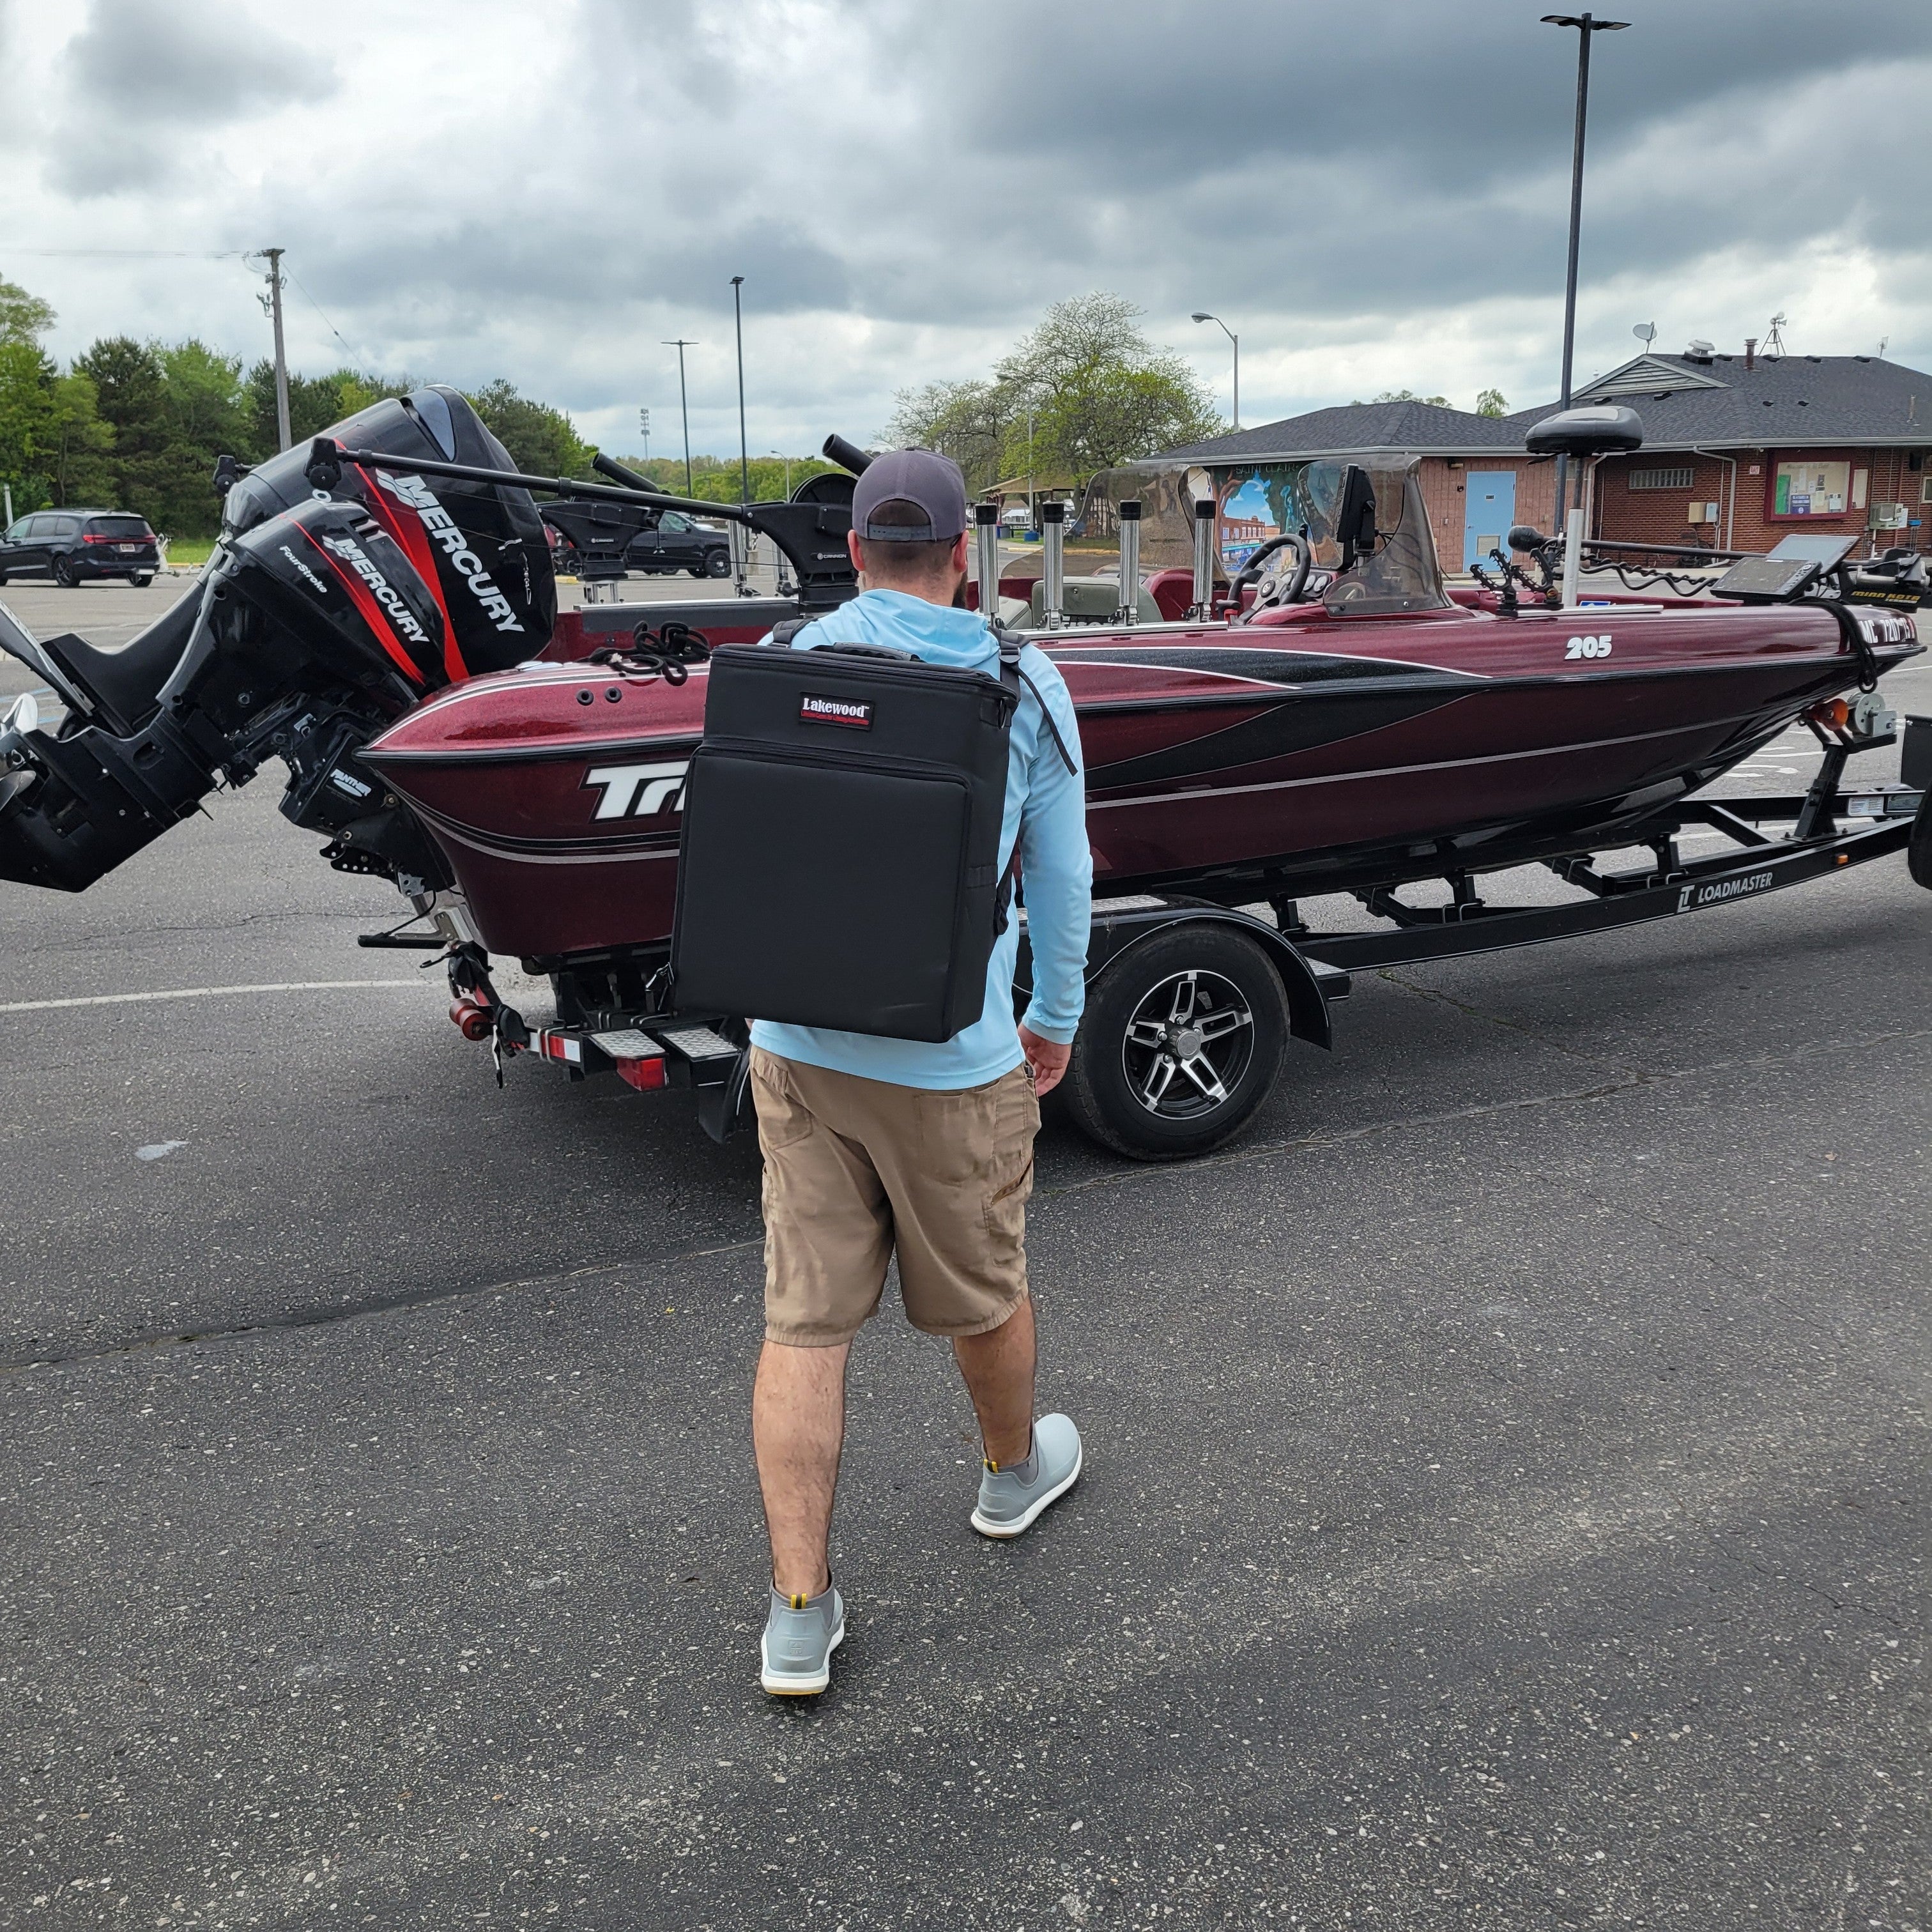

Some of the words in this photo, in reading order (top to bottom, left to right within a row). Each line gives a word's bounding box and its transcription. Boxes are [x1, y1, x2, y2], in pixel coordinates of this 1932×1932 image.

[279, 545, 328, 593] FourStroke
[391, 473, 525, 632] MERCURY
[334, 537, 430, 642] MERCURY
[1564, 635, 1612, 660] 205
[802, 698, 865, 717] Lakewood
[1698, 871, 1774, 904] LOADMASTER
